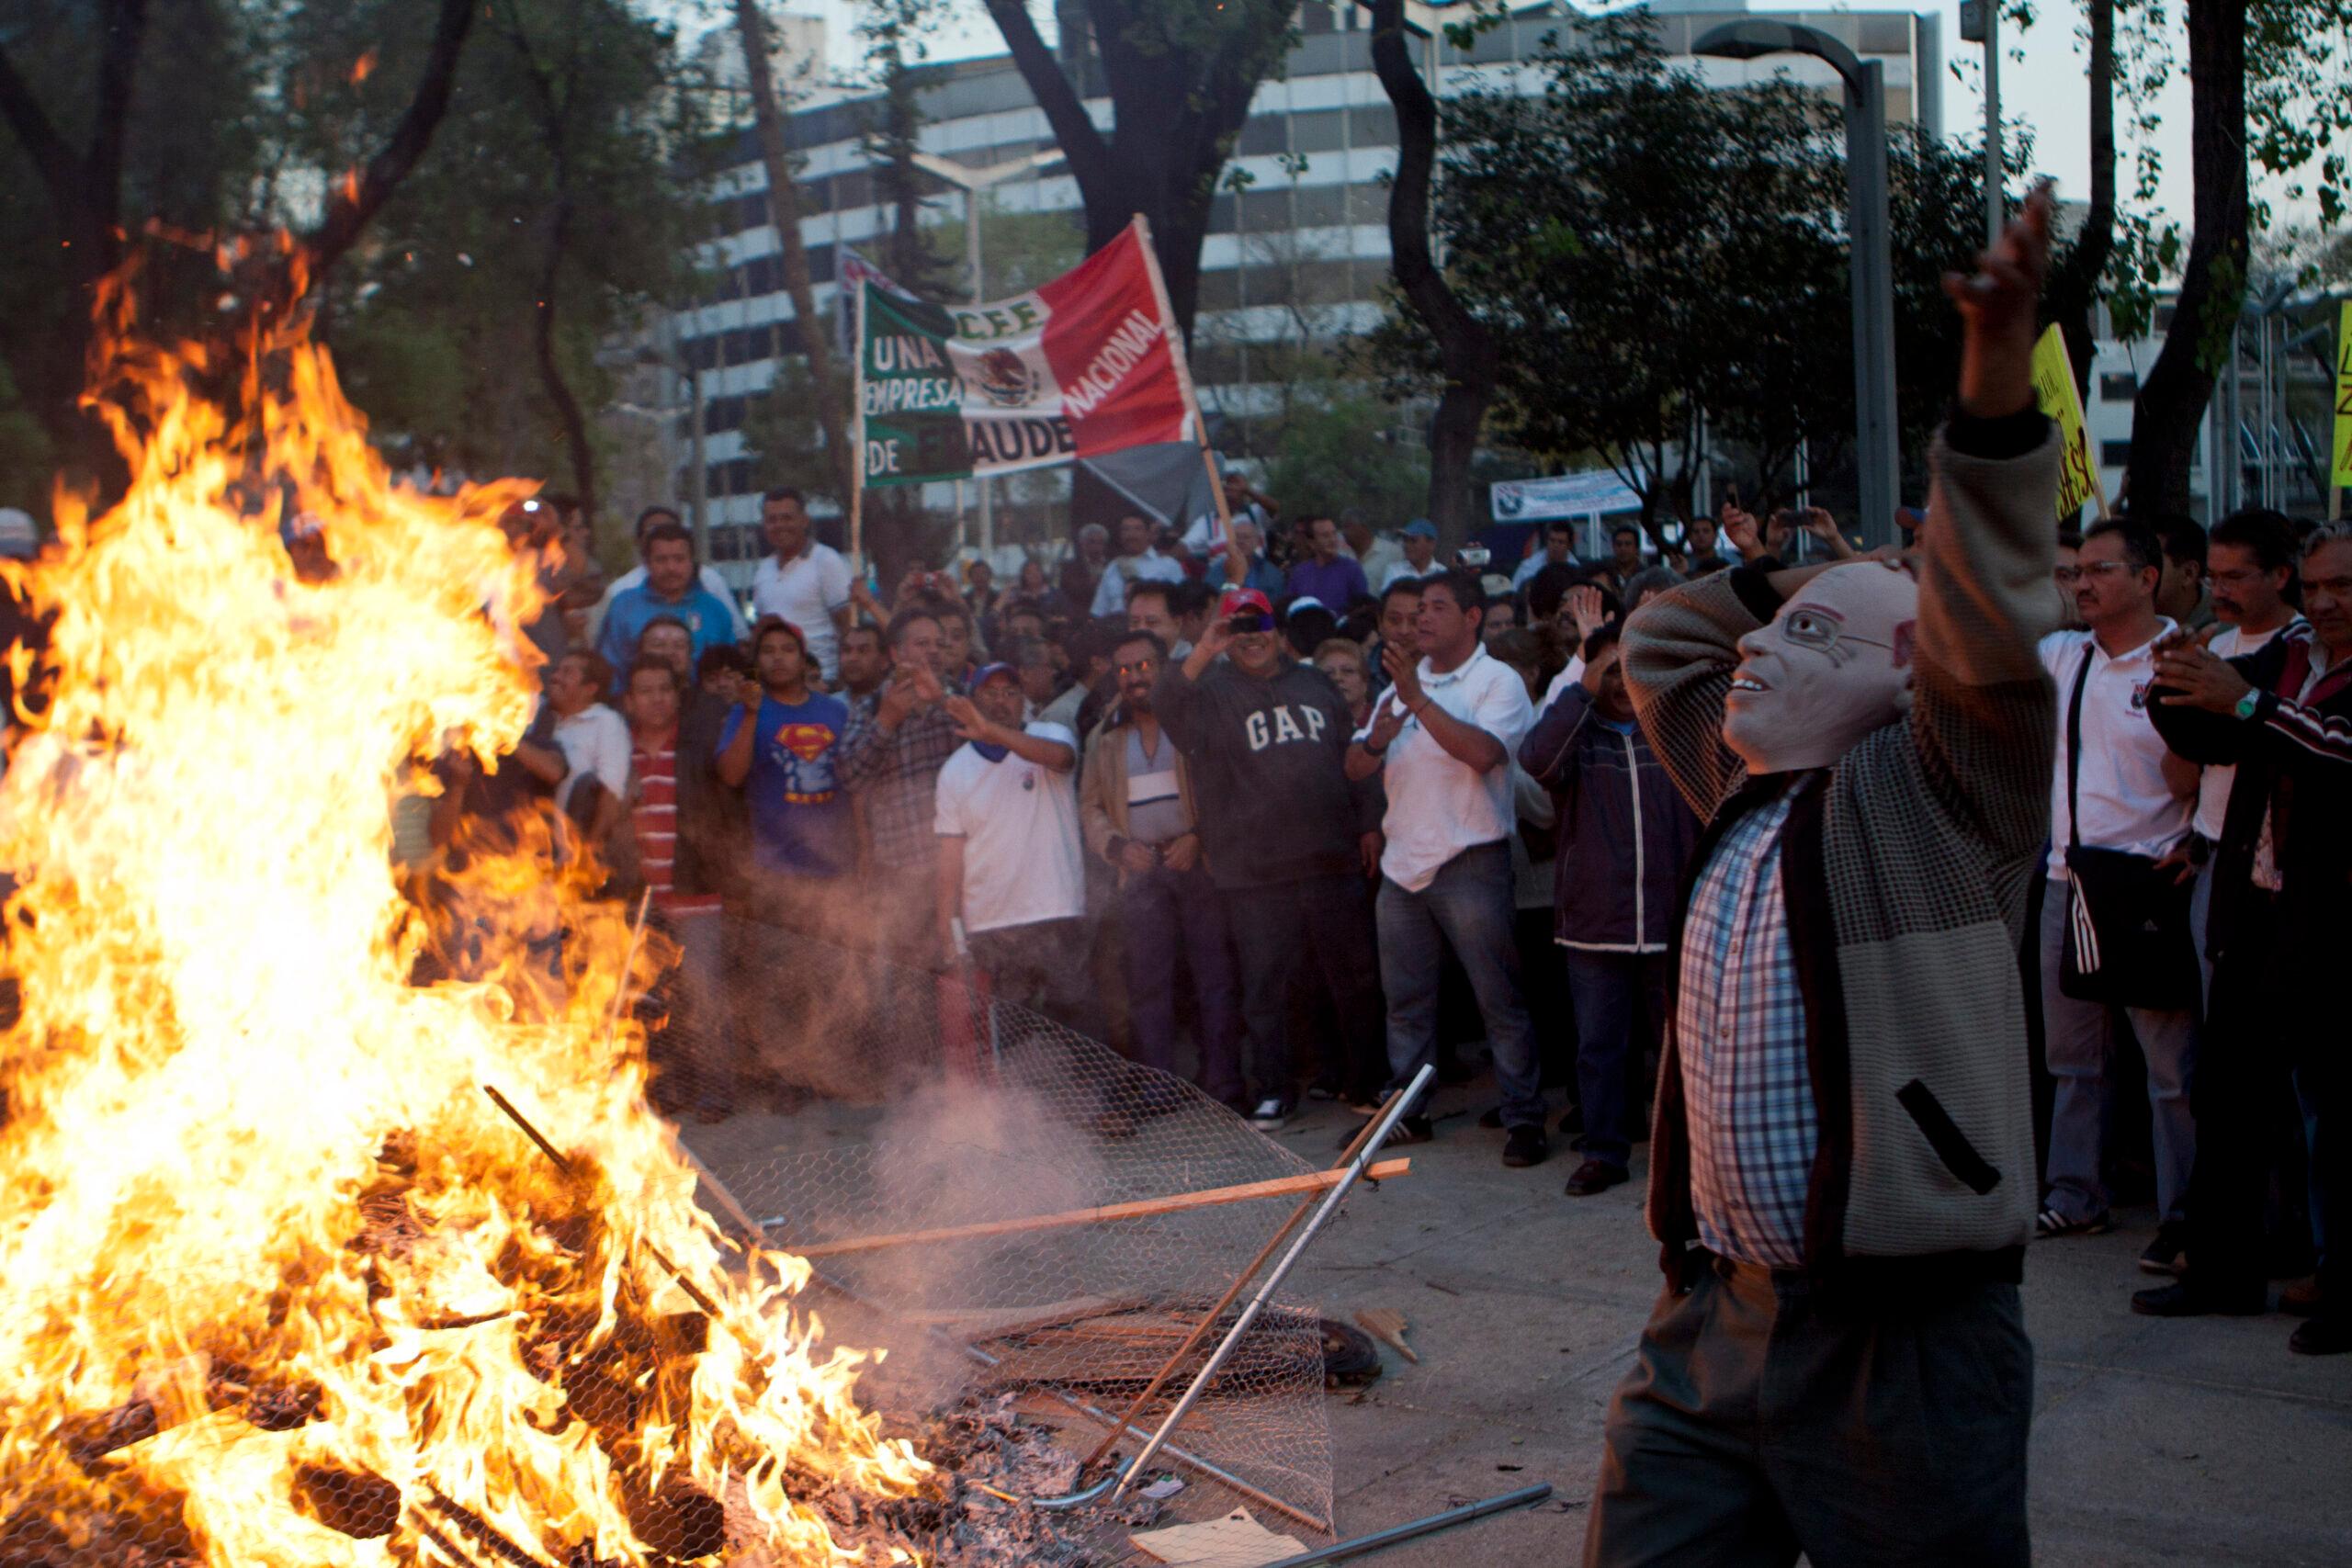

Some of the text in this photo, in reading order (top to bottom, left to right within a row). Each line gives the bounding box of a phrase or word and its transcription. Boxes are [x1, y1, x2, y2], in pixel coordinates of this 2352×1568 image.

[874, 335, 944, 371] UNA
[1061, 309, 1164, 420] NACIONAL
[865, 377, 963, 415] EMPRESA
[868, 438, 900, 476] DE
[1245, 705, 1326, 751] GAP
